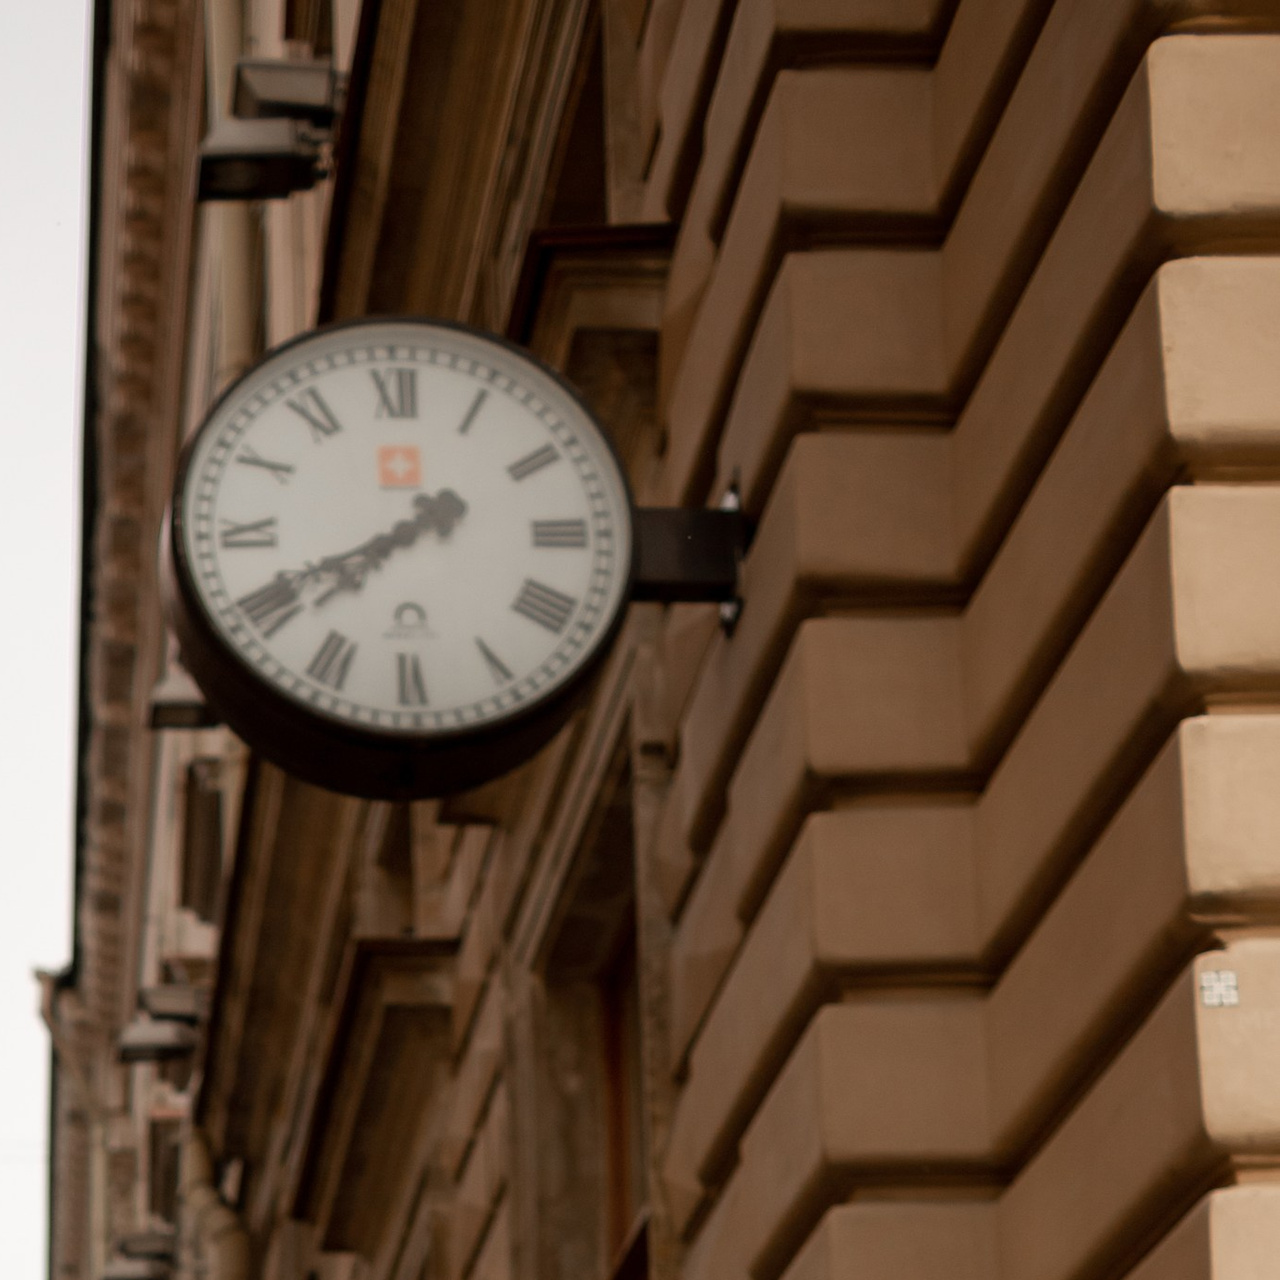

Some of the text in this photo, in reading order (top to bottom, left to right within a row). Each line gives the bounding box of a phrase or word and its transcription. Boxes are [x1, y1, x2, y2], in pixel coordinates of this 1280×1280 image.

[285, 384, 343, 444] XI
[370, 367, 417, 420] XII
[458, 387, 489, 434] I
[235, 443, 297, 486] X
[507, 443, 560, 482] II
[222, 516, 276, 548] IX
[531, 518, 587, 547] III
[511, 577, 577, 635] IIII
[306, 627, 357, 690] VII
[396, 651, 428, 705] VI
[474, 635, 514, 686] V
